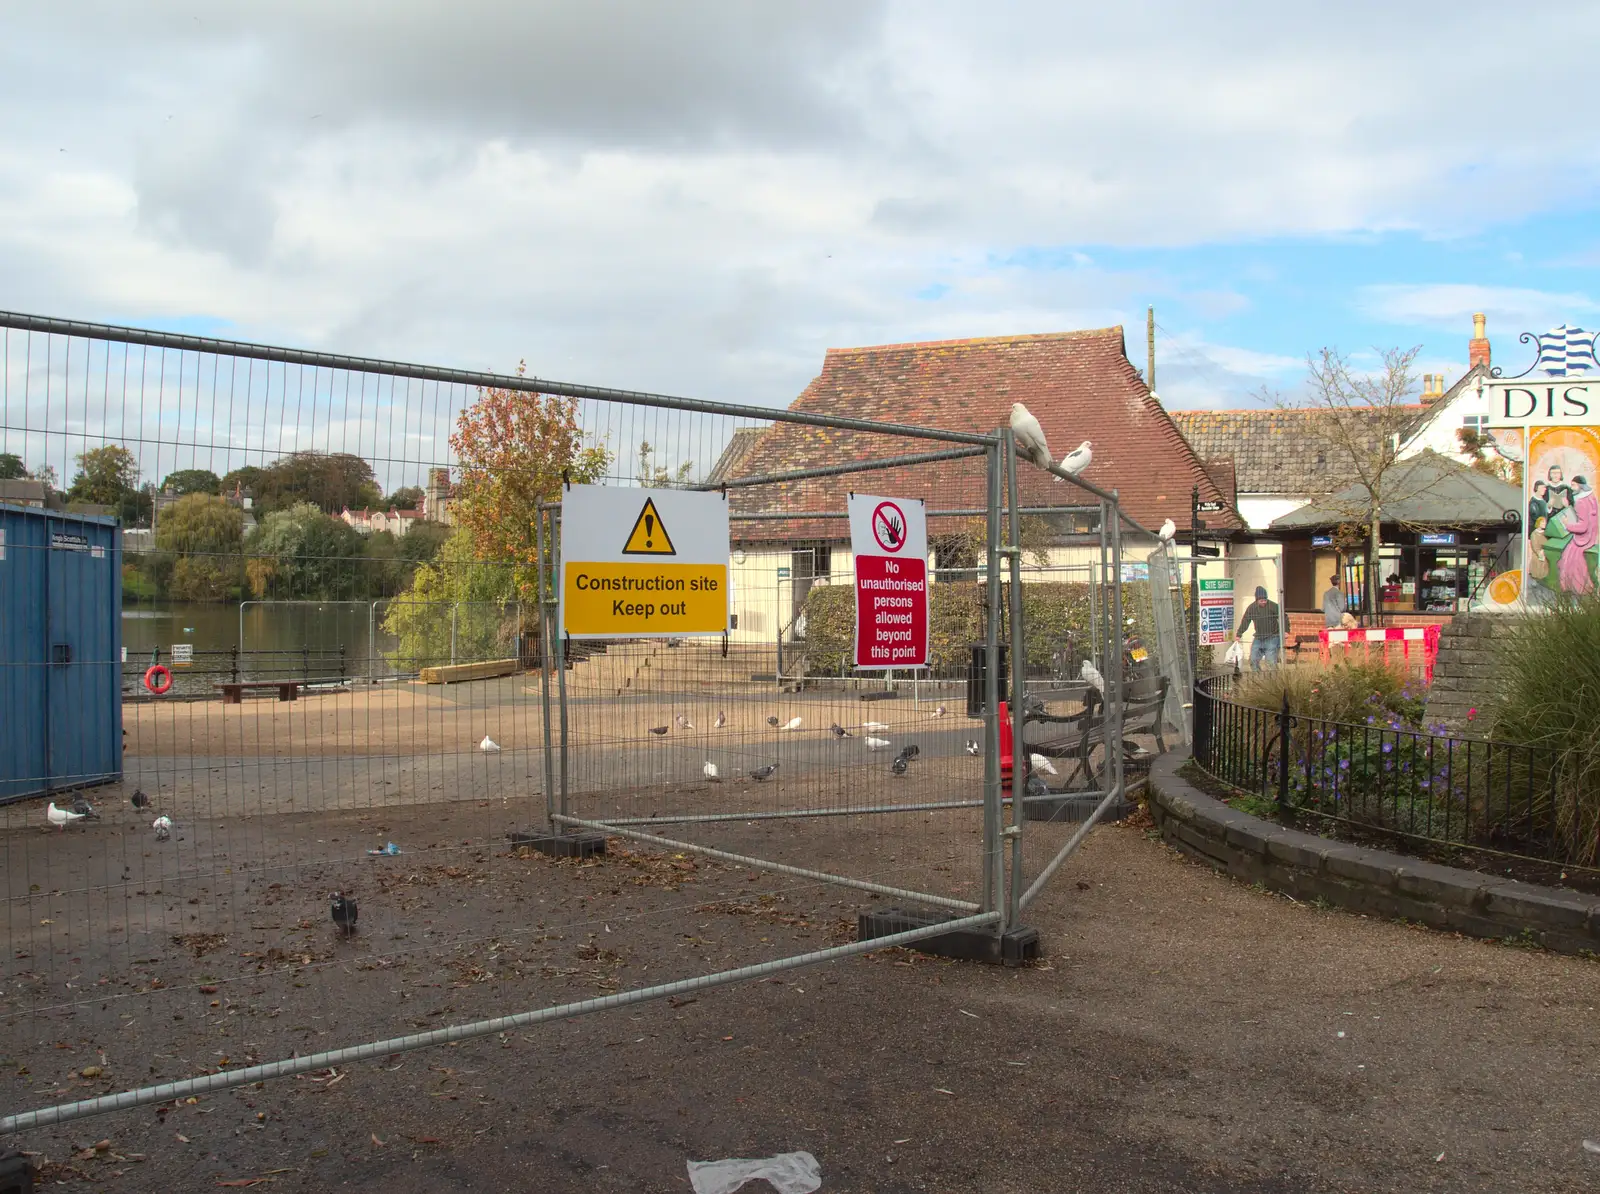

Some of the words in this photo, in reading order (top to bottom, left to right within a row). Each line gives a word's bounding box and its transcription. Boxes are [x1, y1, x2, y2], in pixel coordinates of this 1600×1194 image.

[885, 560, 900, 574] No
[576, 574, 685, 591] Construction
[690, 575, 718, 591] site
[860, 577, 924, 592] unauthorised
[1205, 580, 1217, 590] SITE
[612, 600, 655, 619] Keep
[660, 601, 686, 616] out
[874, 596, 913, 610] persons
[875, 611, 912, 624] allowed
[876, 628, 912, 644] beyond
[871, 645, 890, 658] this
[892, 645, 916, 661] point
